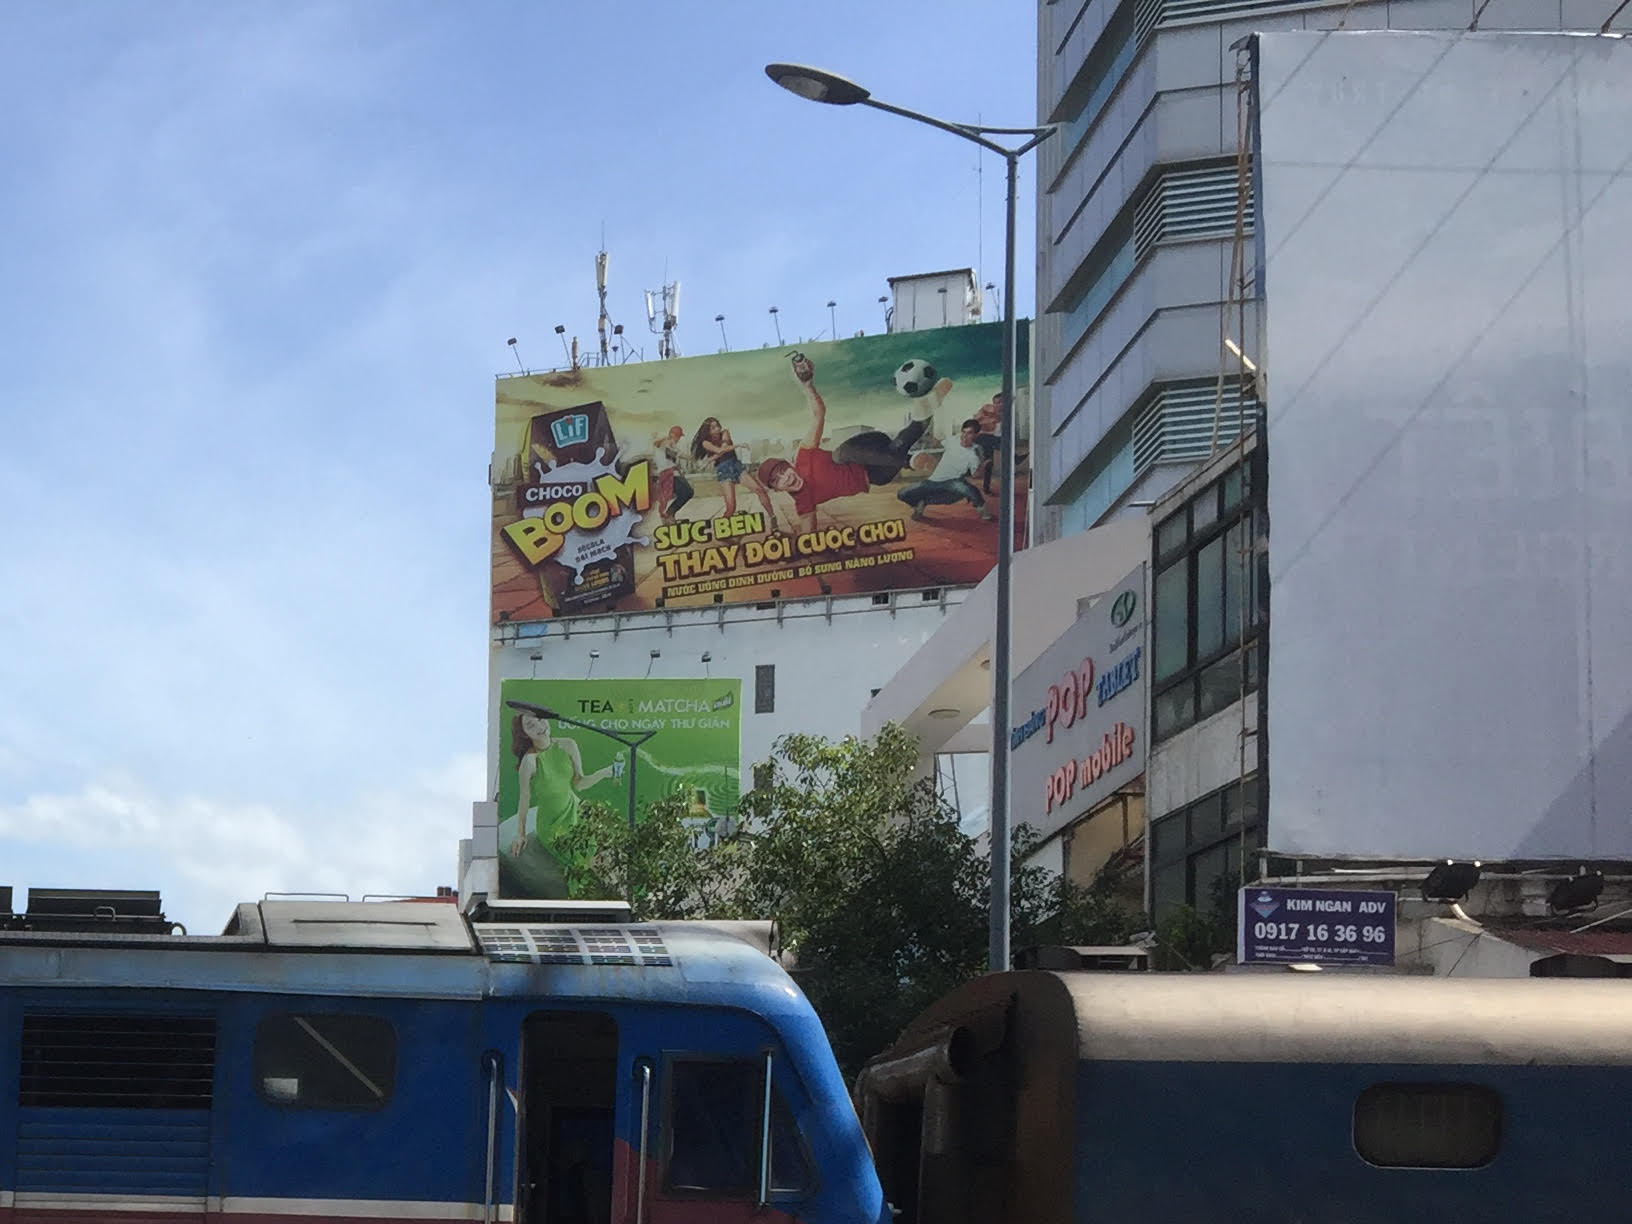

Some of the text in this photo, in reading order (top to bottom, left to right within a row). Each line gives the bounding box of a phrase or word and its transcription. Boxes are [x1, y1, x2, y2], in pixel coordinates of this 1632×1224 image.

[500, 459, 651, 567] BOOM
[525, 484, 583, 502] CHOCO
[658, 544, 739, 581] THAY
[796, 526, 856, 555] CUỘC
[858, 519, 906, 544] CHƠI
[578, 699, 614, 714] TEA
[638, 698, 711, 714] MATCHA
[1044, 656, 1094, 745] POP
[1045, 758, 1078, 816] POP
[1079, 720, 1135, 790] mobile
[1286, 898, 1387, 914] KIM NGAN ADV
[1254, 921, 1386, 943] 0917 16 36 96
